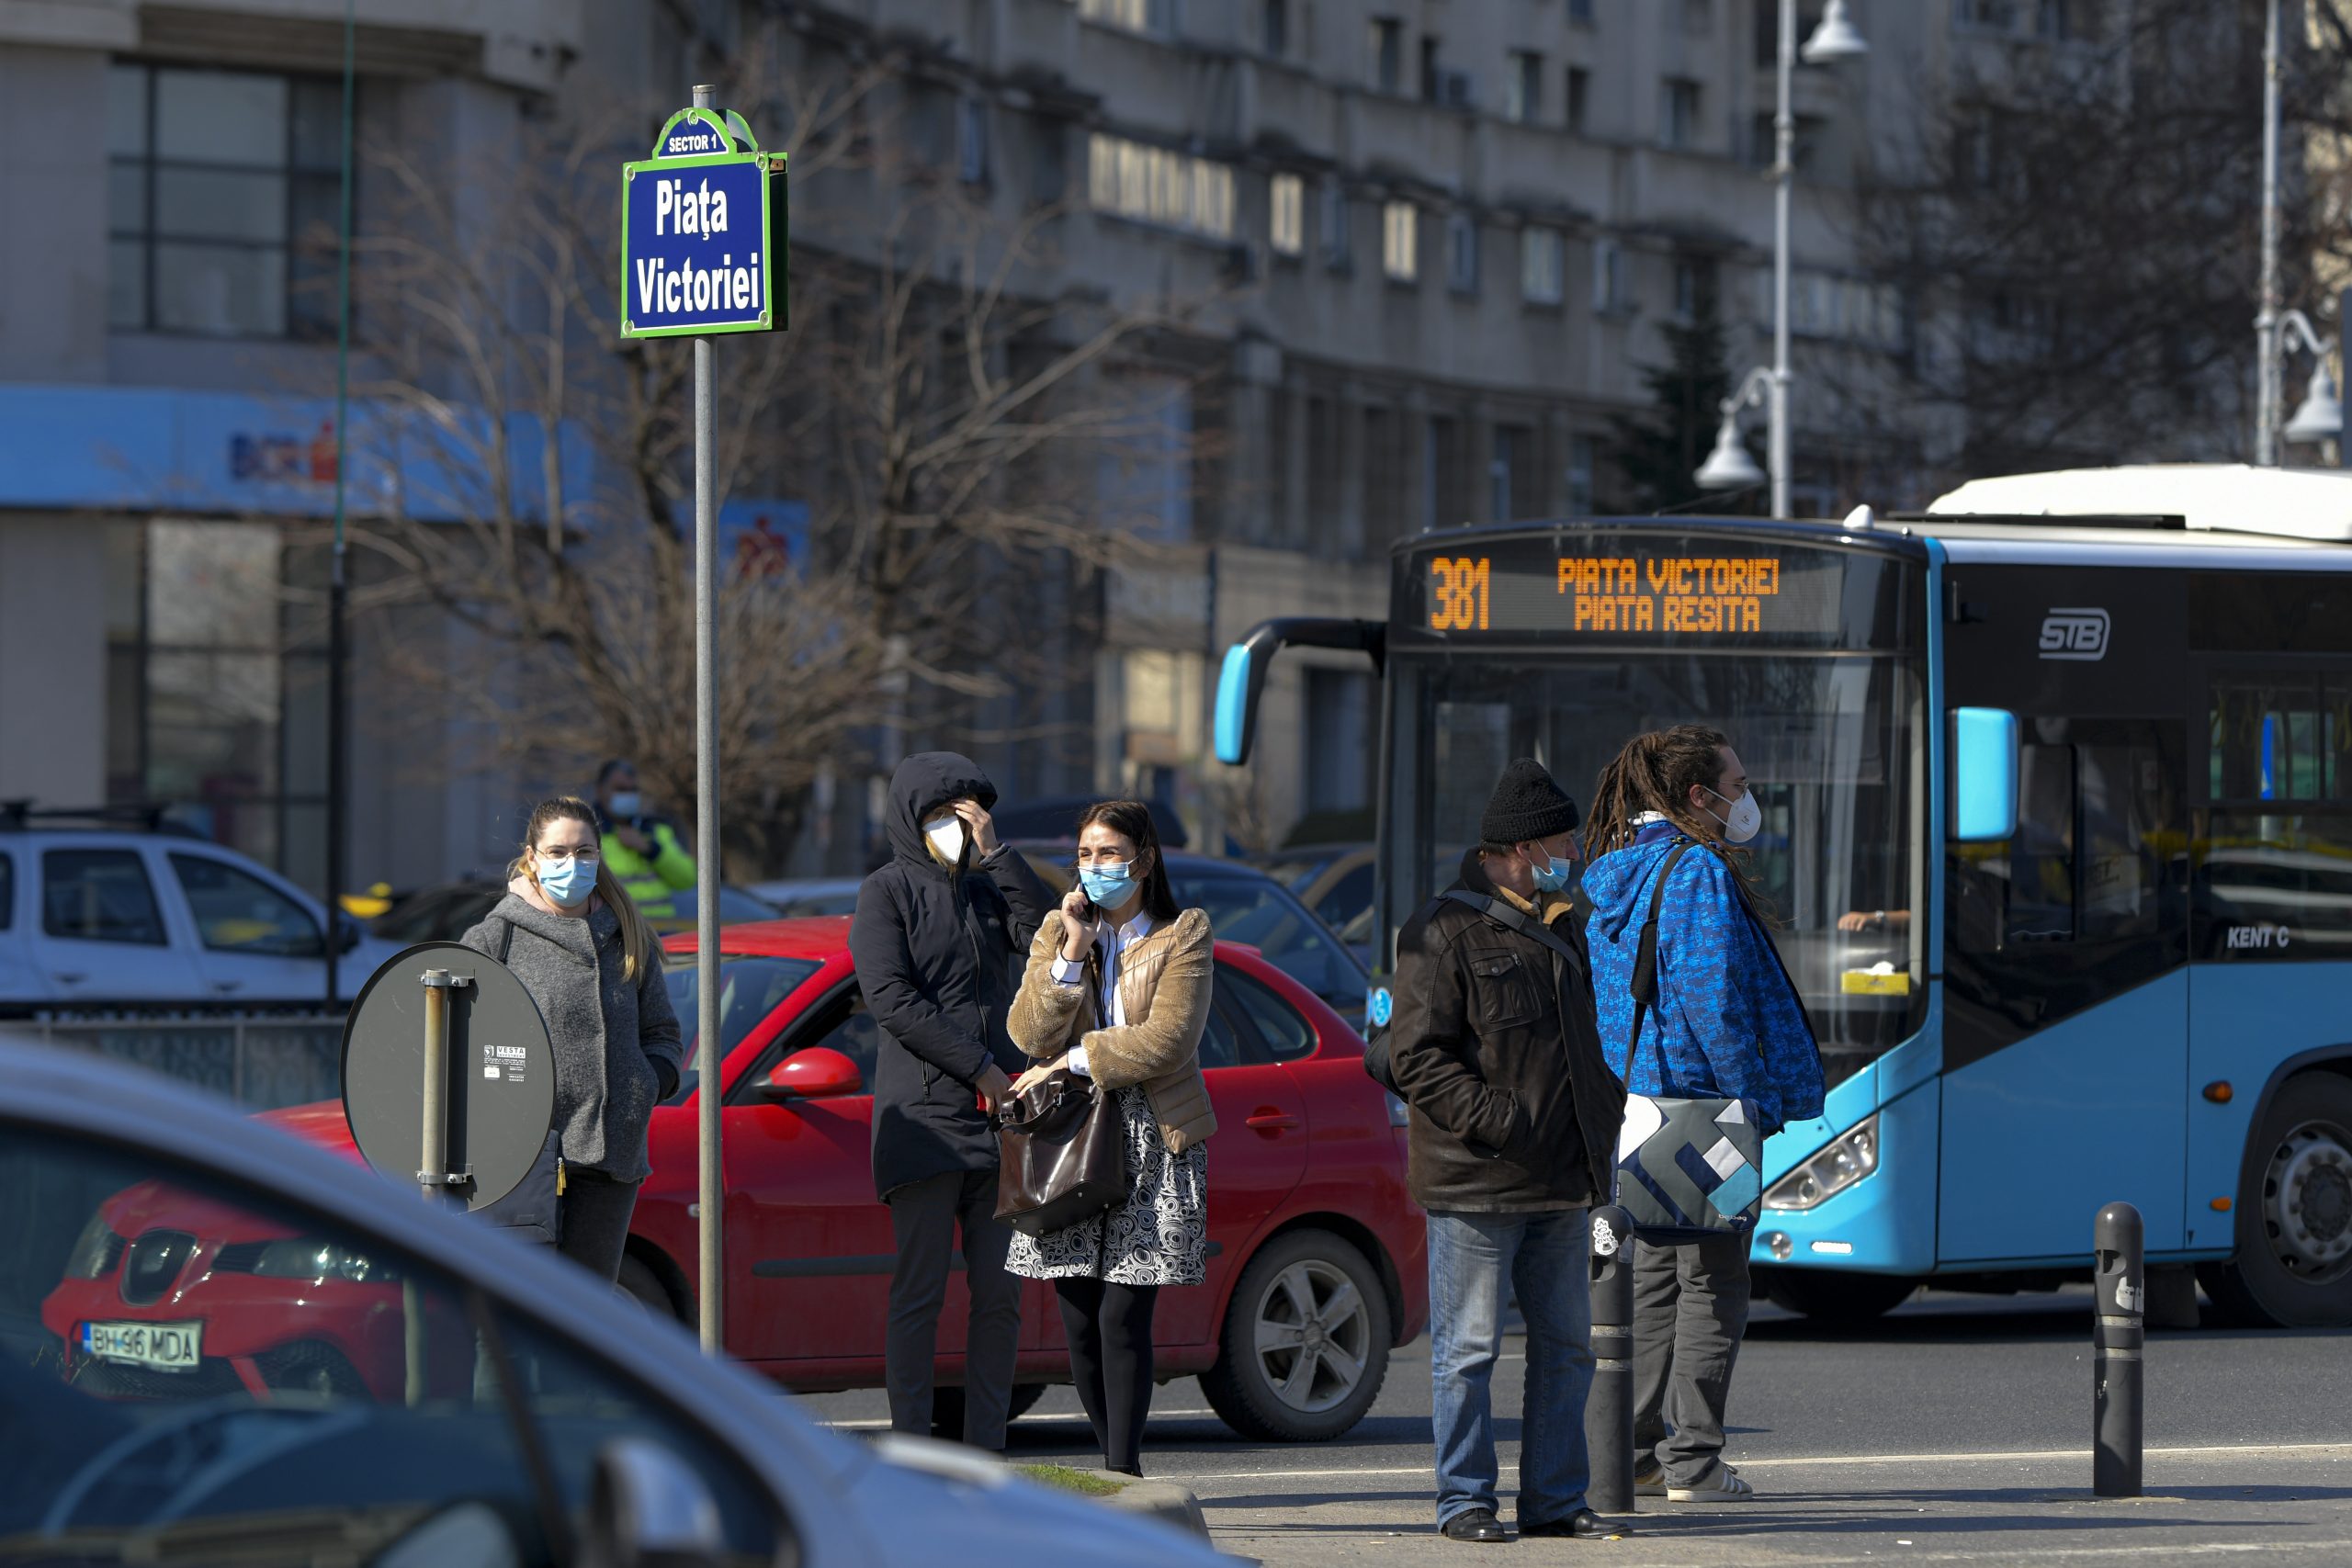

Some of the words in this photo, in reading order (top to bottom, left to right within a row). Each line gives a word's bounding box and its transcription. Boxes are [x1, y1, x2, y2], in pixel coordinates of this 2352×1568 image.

[669, 135, 709, 152] SECTOR
[711, 133, 717, 149] 1
[637, 252, 759, 314] Victoriei
[1558, 558, 1637, 594] PIATA
[1646, 558, 1780, 594] VICTORIEI
[1430, 558, 1490, 630] 381
[1575, 595, 1654, 632] PIATA
[1663, 595, 1760, 632] RESITA
[2039, 616, 2104, 650] STB
[2226, 926, 2273, 949] KENT
[2276, 925, 2290, 948] C
[93, 1328, 118, 1352] BH
[120, 1328, 145, 1356] 96
[150, 1329, 194, 1362] MDA
